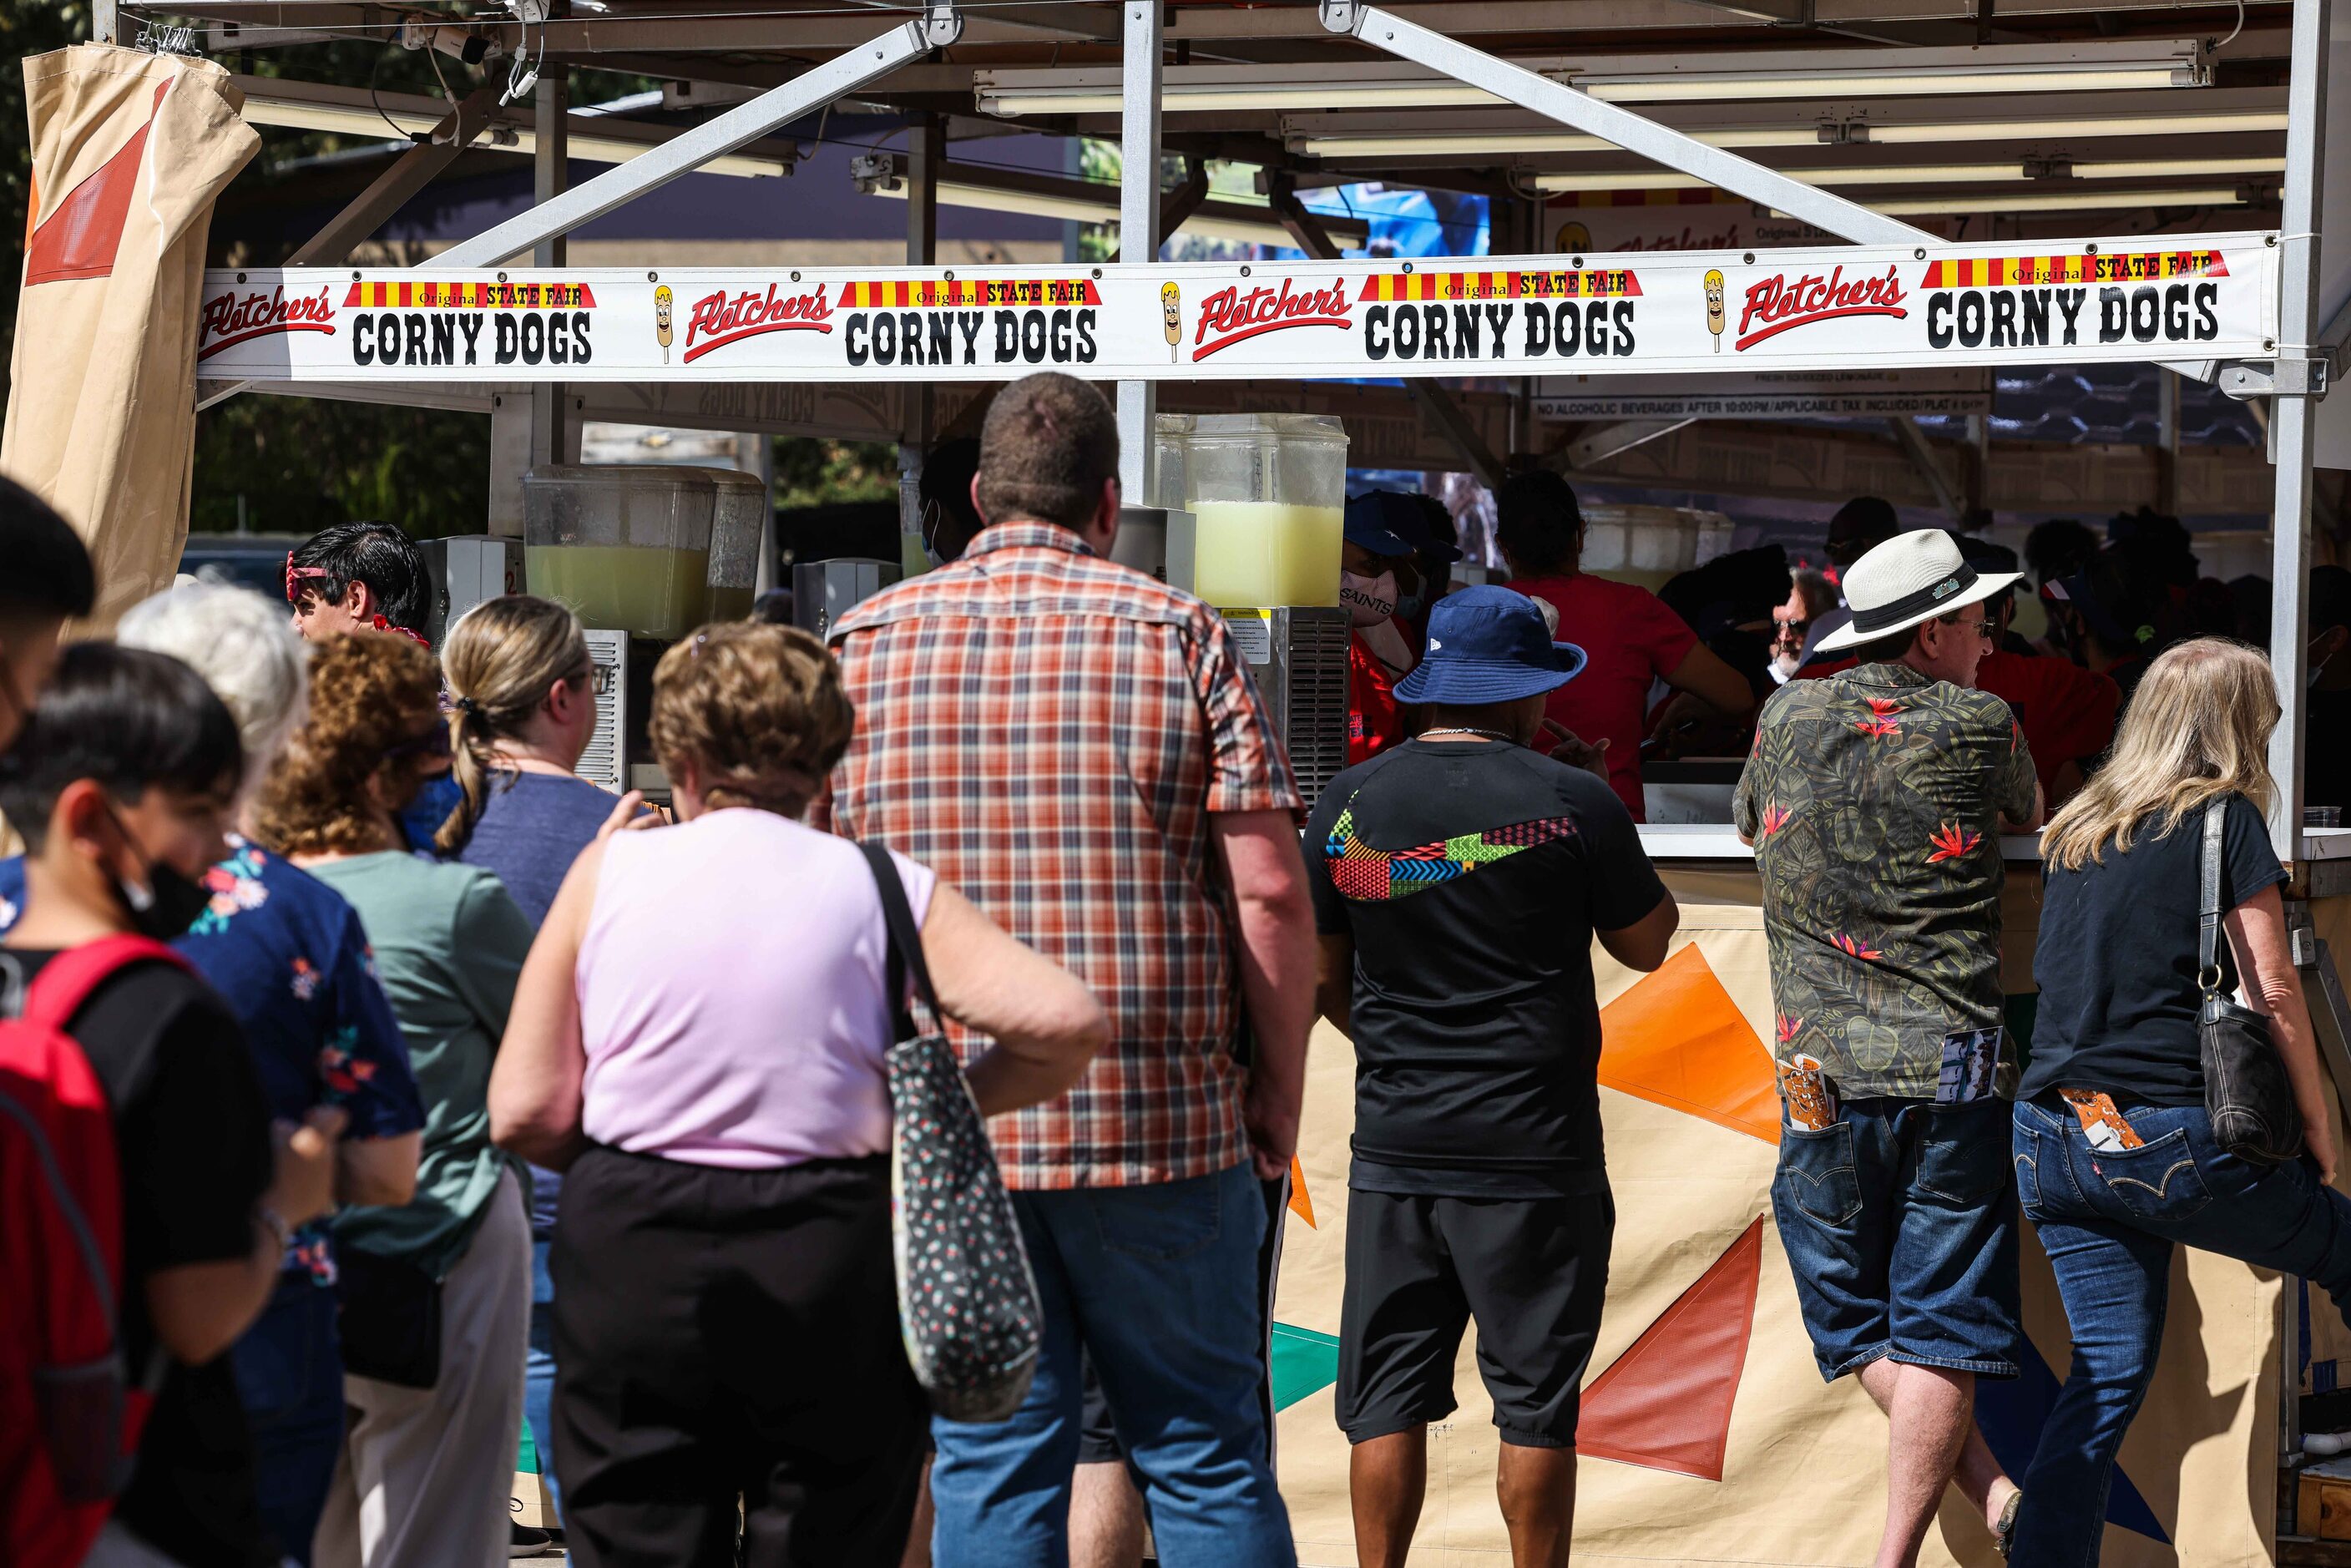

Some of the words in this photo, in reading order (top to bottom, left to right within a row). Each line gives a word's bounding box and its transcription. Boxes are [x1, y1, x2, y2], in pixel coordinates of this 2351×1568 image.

[419, 292, 481, 307] Original
[487, 286, 539, 305] STATE
[545, 286, 583, 306] FAIR
[917, 291, 979, 306] Original
[987, 284, 1042, 301] STATE
[1048, 284, 1087, 301] FAIR
[1444, 283, 1513, 299] Original
[1520, 275, 1580, 294] STATE
[1586, 273, 1628, 292] FAIR
[2012, 266, 2086, 284] Original
[2095, 257, 2160, 278] STATE
[2168, 255, 2213, 276] FAIR
[198, 285, 336, 347] Fletcher's
[686, 282, 834, 346] Fletcher's
[1195, 277, 1352, 345] Fletcher's
[1738, 265, 1908, 336] Fletcher's
[1927, 287, 2086, 348] CORNY
[2099, 283, 2218, 342] DOGS
[352, 312, 483, 366] CORNY
[494, 311, 592, 365] DOGS
[845, 311, 983, 366] CORNY
[994, 309, 1097, 363] DOGS
[1365, 303, 1514, 360] CORNY
[1524, 301, 1636, 357] DOGS
[1538, 402, 1553, 414] NO
[1555, 402, 1617, 414] ALCOHOLIC
[1621, 402, 1684, 413] BEVERAGES
[1687, 402, 1722, 413] AFTER
[1843, 399, 1862, 412] TAX
[505, 570, 518, 594] 2
[1340, 588, 1393, 615] SAINTS
